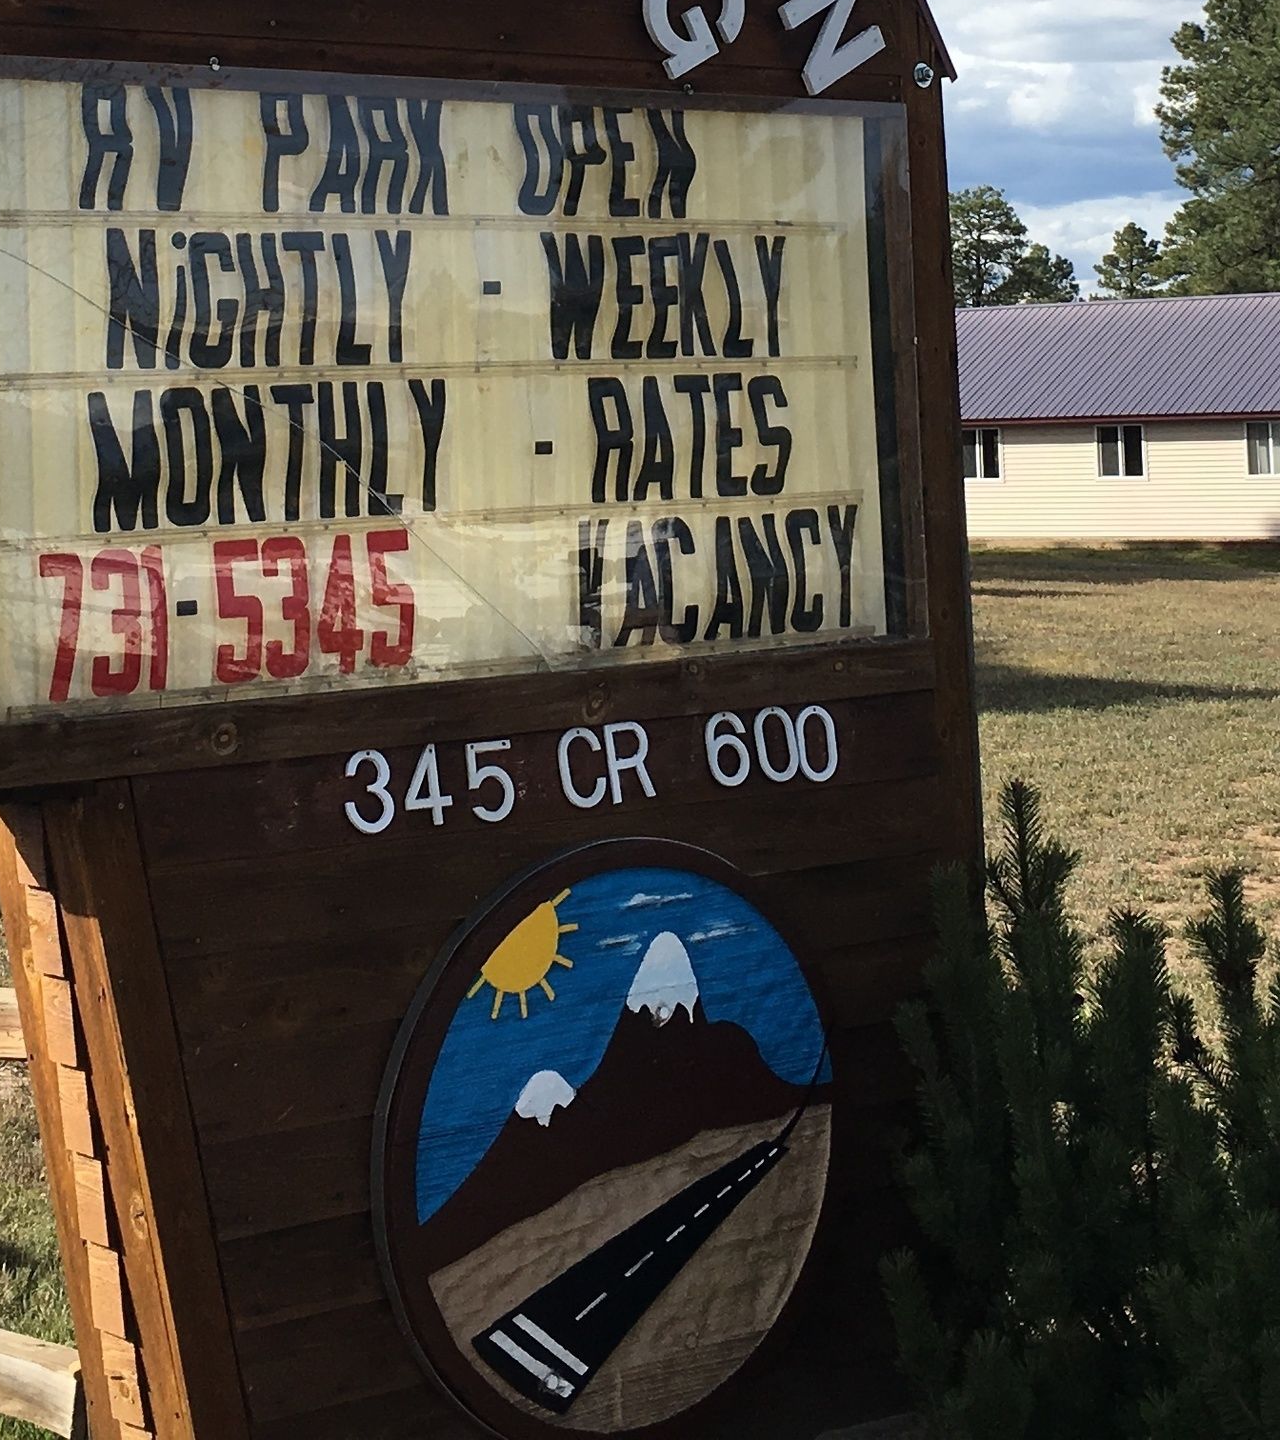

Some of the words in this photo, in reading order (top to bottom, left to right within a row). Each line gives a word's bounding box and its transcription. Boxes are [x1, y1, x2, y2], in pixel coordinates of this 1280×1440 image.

[80, 83, 194, 212] RV
[260, 91, 449, 216] PARK
[513, 103, 698, 220] OPEN
[540, 232, 787, 360] WEEKLY
[87, 379, 447, 532] MONTHLY
[589, 372, 792, 504] RATES
[39, 528, 415, 702] 731-5345
[577, 504, 859, 649] VACANCY
[344, 739, 516, 835] 345
[557, 721, 657, 809] CR
[705, 705, 838, 787] 600
